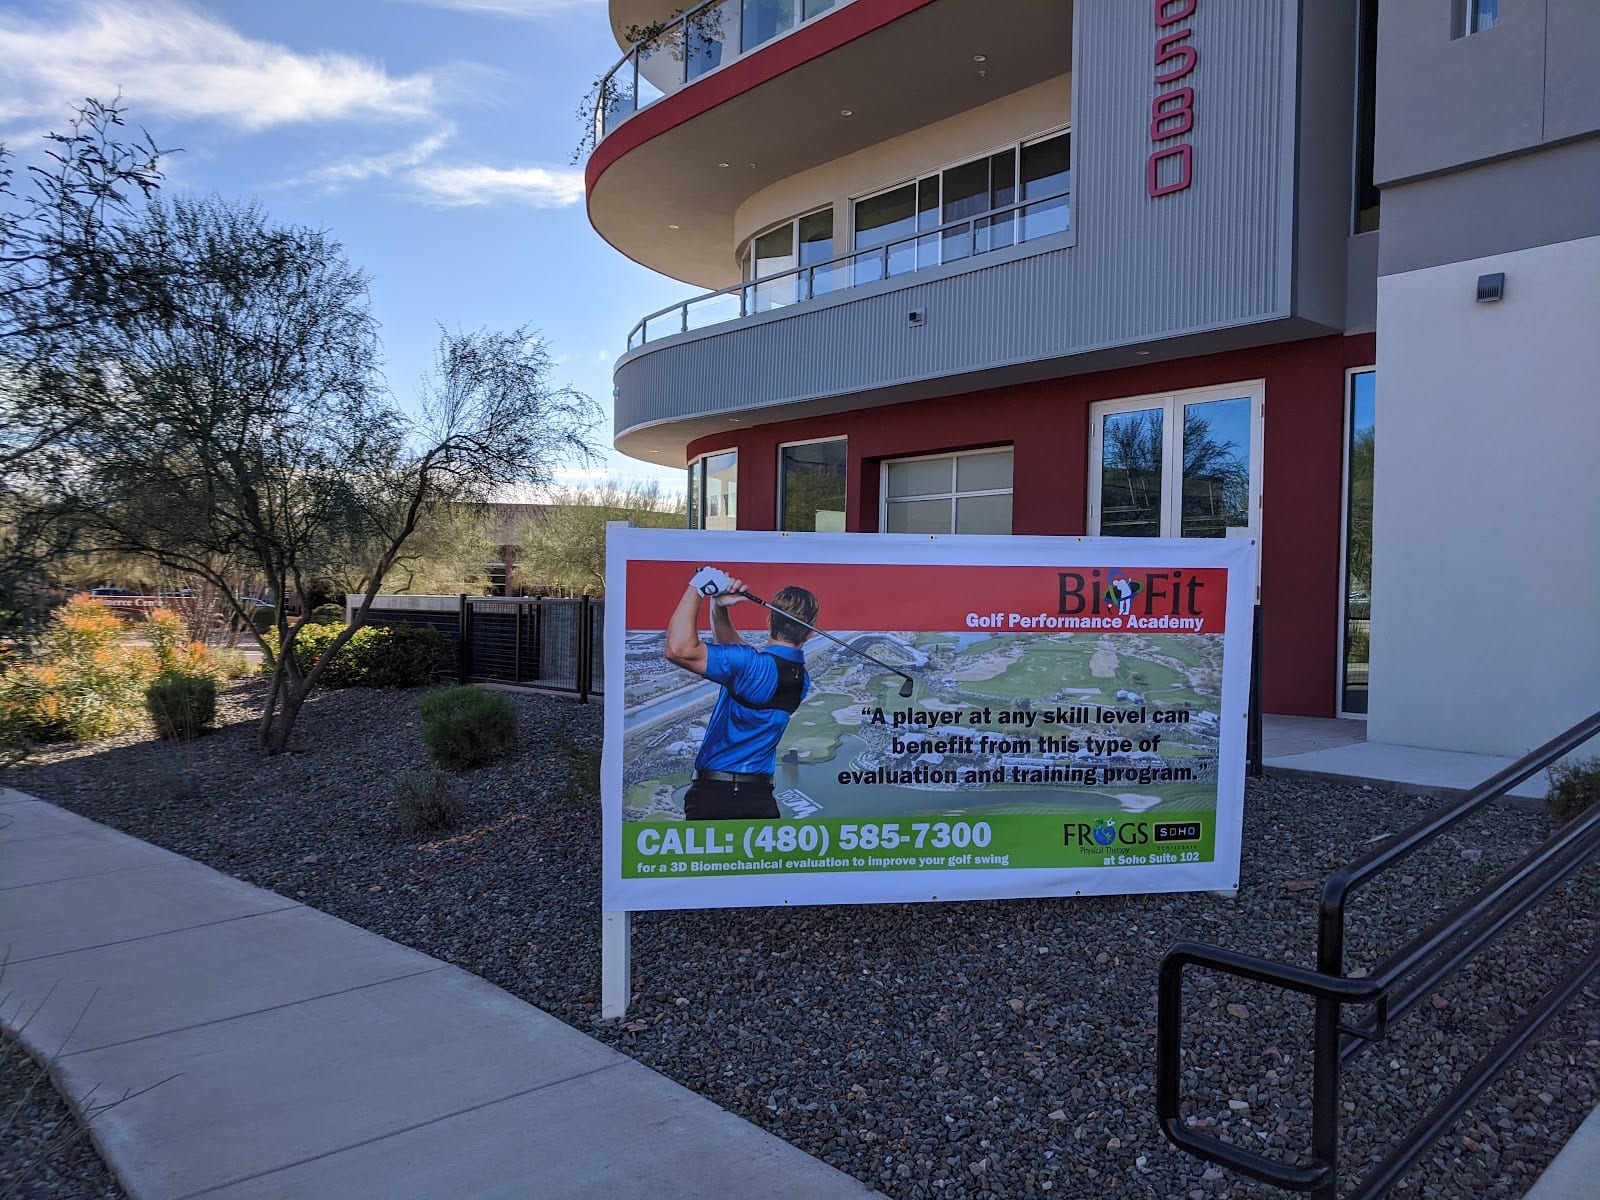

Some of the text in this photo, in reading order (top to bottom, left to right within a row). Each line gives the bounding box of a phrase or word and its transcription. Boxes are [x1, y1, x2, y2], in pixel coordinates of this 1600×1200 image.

[965, 612, 1204, 632] Golf Performance Academy
[861, 706, 1190, 729] “A player at any skill level can
[891, 735, 1161, 757] benefit from this type of
[837, 763, 1208, 786] evaluation and training program.”
[637, 821, 992, 858] CALL: (480) 585-7300
[1159, 826, 1195, 837] SOHO
[637, 853, 1010, 873] for a 3D Biomechanical evaluation to improve your golf swing
[1103, 851, 1200, 866] at Soho Suite 102
